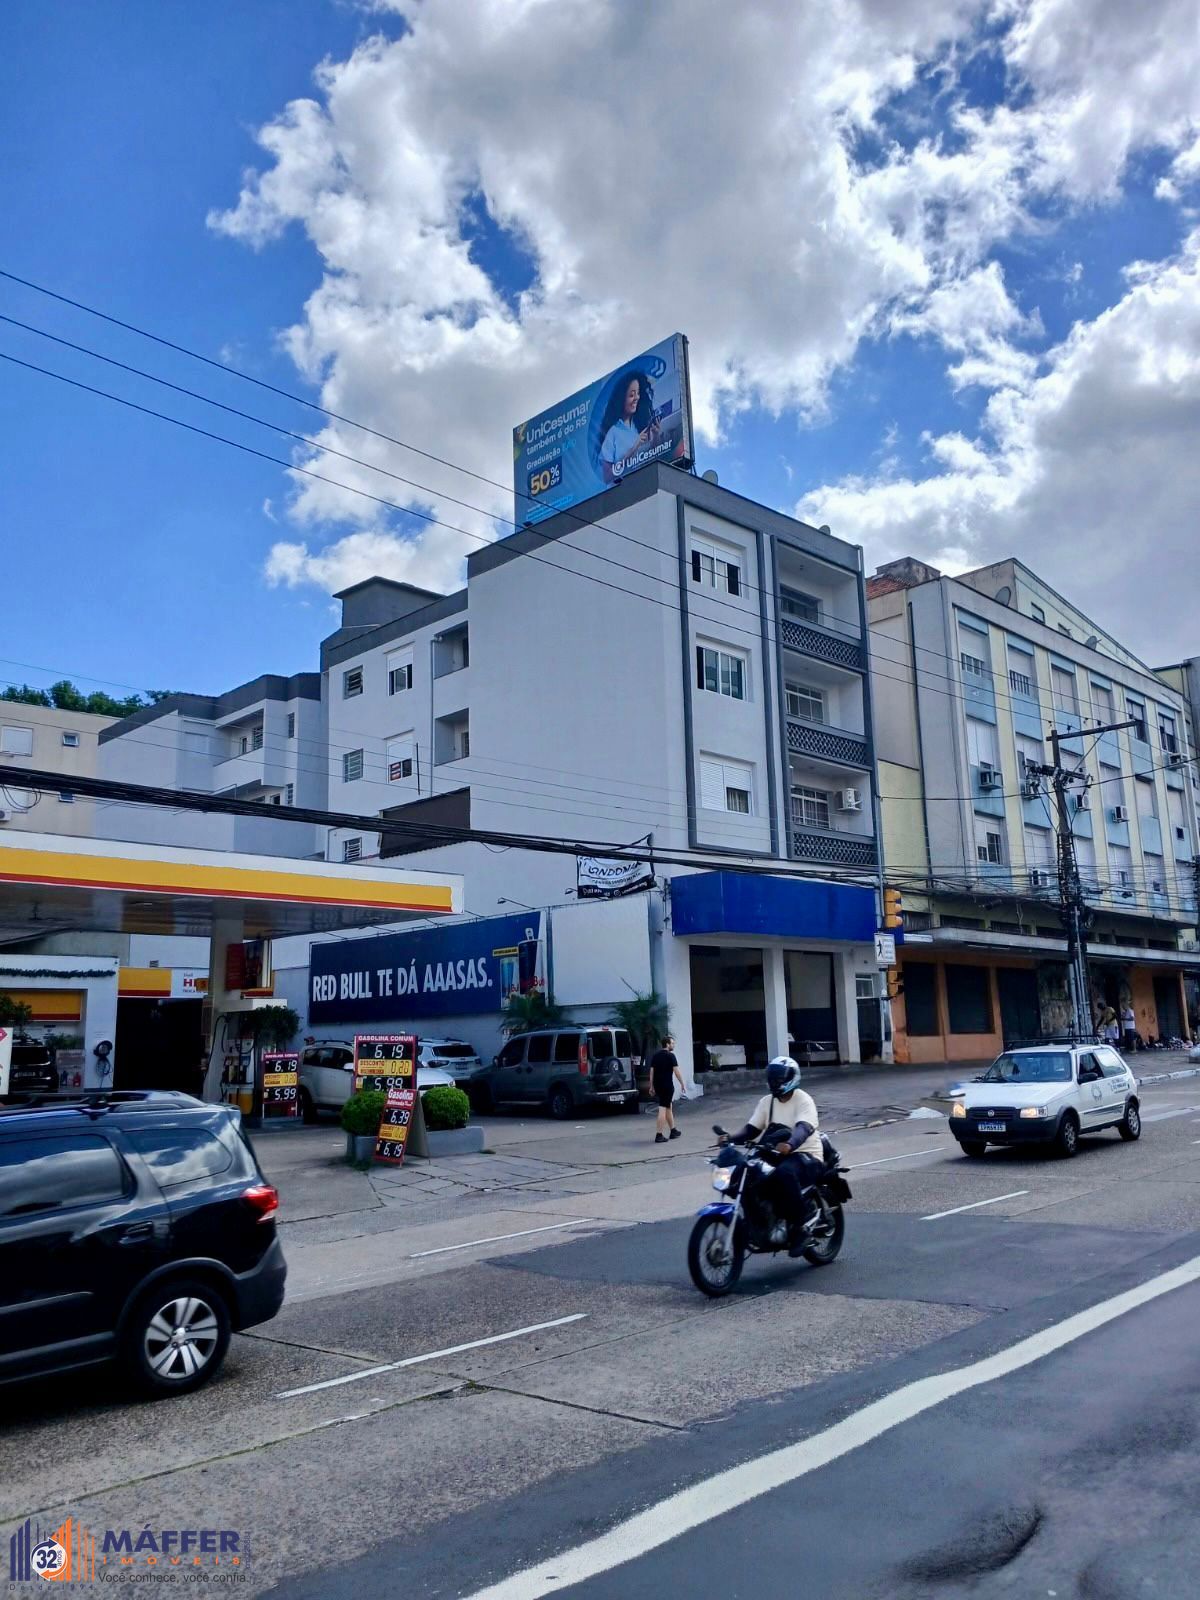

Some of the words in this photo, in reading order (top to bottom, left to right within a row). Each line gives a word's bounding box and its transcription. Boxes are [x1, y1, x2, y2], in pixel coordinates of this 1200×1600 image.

[526, 400, 591, 443] UniCesumar
[526, 434, 556, 455] também
[564, 424, 574, 435] do
[575, 415, 587, 429] RS
[526, 448, 561, 470] Graduação
[626, 440, 672, 468] UniCesumar
[312, 975, 337, 1002] RED
[340, 971, 373, 1000] BULL
[377, 968, 393, 997] TE
[397, 958, 418, 996] DÁ
[422, 957, 493, 993] AAASAS.
[374, 1044, 404, 1059] 6,19
[274, 1060, 298, 1072] 6,19
[391, 1060, 409, 1075] 0,20
[374, 1077, 404, 1092] 5,99
[274, 1088, 297, 1101] 5,99
[388, 1088, 414, 1100] Gasolina
[390, 1110, 410, 1124] 6,39
[383, 1142, 403, 1157] 6,19
